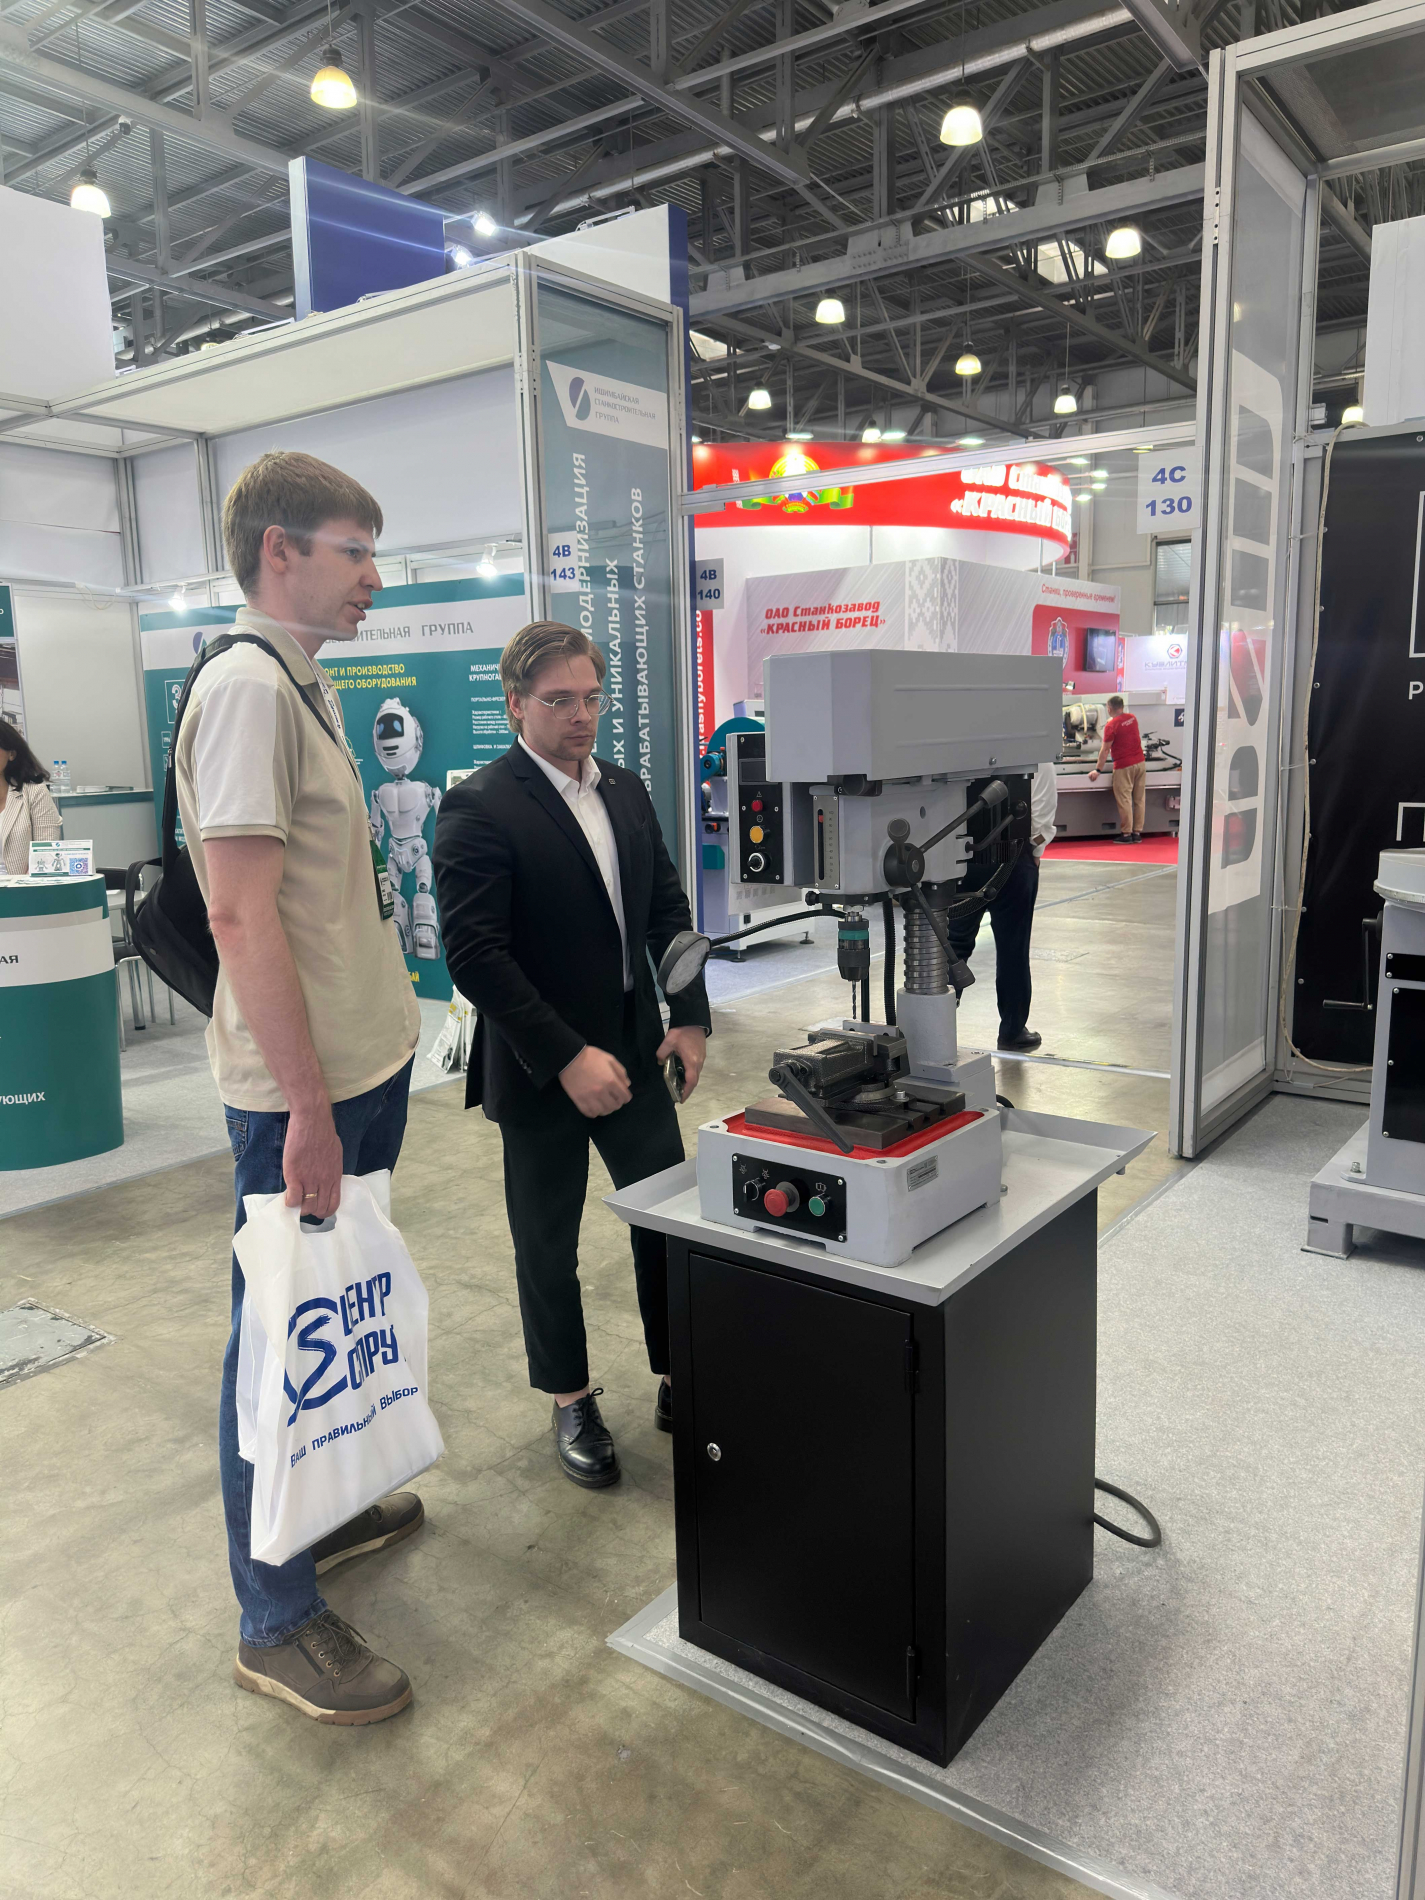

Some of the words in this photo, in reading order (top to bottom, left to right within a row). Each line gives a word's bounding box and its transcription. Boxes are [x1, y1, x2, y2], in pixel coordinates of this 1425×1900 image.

[594, 386, 640, 405] ИШИМБАЙСКАЯ
[594, 398, 656, 420] СТАНКОСТРОИТЕЛЬНАЯ
[595, 411, 620, 424] ГРУППА
[1145, 495, 1193, 517] 130
[631, 487, 646, 589] СТАНКОВ
[550, 566, 576, 581] 143
[697, 588, 721, 601] 140
[764, 606, 790, 620] ОАО
[792, 600, 881, 617] Станкозавод
[421, 621, 474, 637] ГРУППА
[760, 616, 831, 635] «КРАСНЫЙ
[834, 615, 886, 630] БОРЕЦ»
[606, 558, 624, 713] УНИКАЛЬНЫХ
[340, 667, 346, 677] И
[346, 663, 405, 676] ПРОИЗВОДСТВО
[355, 676, 417, 689] ОБОРУДОВАНИЯ
[634, 595, 652, 800] БРАБАТЫВАЮЩИХ
[612, 718, 624, 734] И
[347, 1324, 400, 1391] СПРУ
[290, 1445, 307, 1468] ВАШ
[311, 1403, 377, 1451] ПРАВИЛЬНЫЙ
[379, 1386, 419, 1411] ВЫБОР
